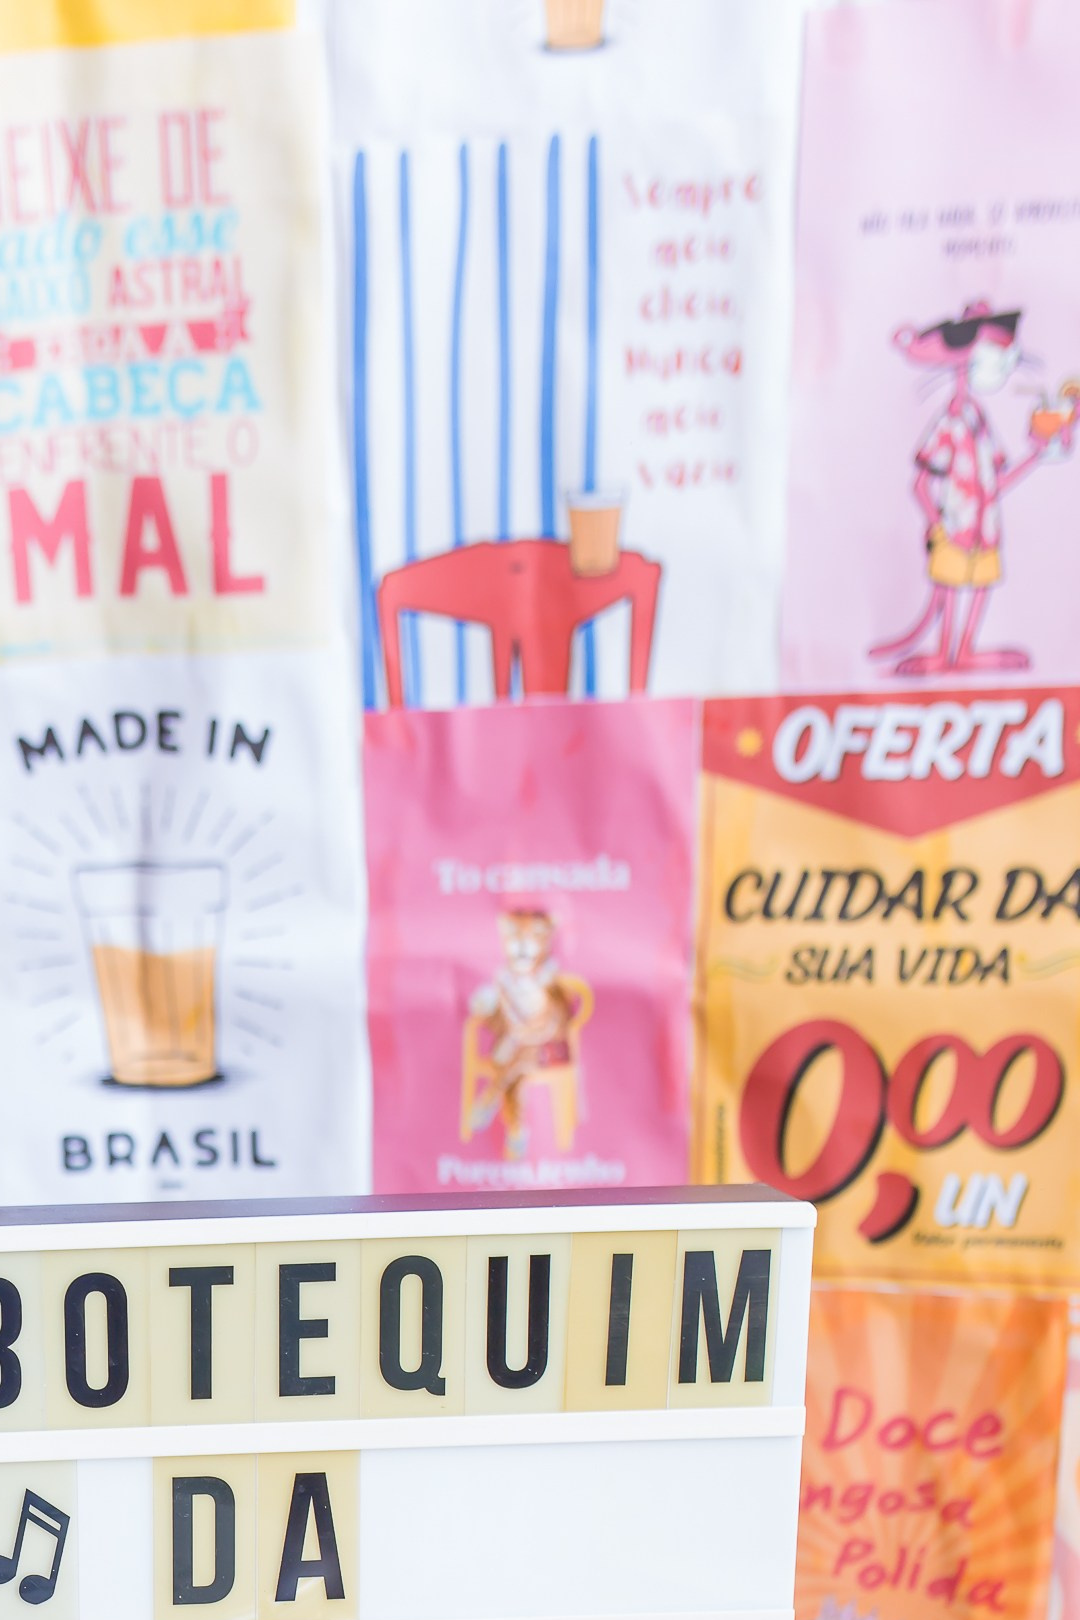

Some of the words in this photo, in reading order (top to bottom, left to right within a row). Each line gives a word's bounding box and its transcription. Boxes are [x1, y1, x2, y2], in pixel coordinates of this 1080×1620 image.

[157, 108, 230, 208] DE
[7, 472, 265, 605] MAL
[18, 711, 181, 772] MADE
[208, 718, 271, 764] IN
[772, 698, 1066, 784] OFERTA
[722, 867, 980, 926] CUIDAR
[994, 866, 1080, 924] DA
[784, 943, 875, 986] SUA
[897, 943, 1011, 986] VIDA
[62, 1128, 277, 1172] BRASIL
[739, 1017, 1066, 1246] 0,00
[933, 1171, 1030, 1229] UN
[821, 1386, 1003, 1460] Doce
[170, 1470, 347, 1607] DA
[800, 1480, 976, 1530] ngosa
[832, 1537, 1007, 1615] Polida
